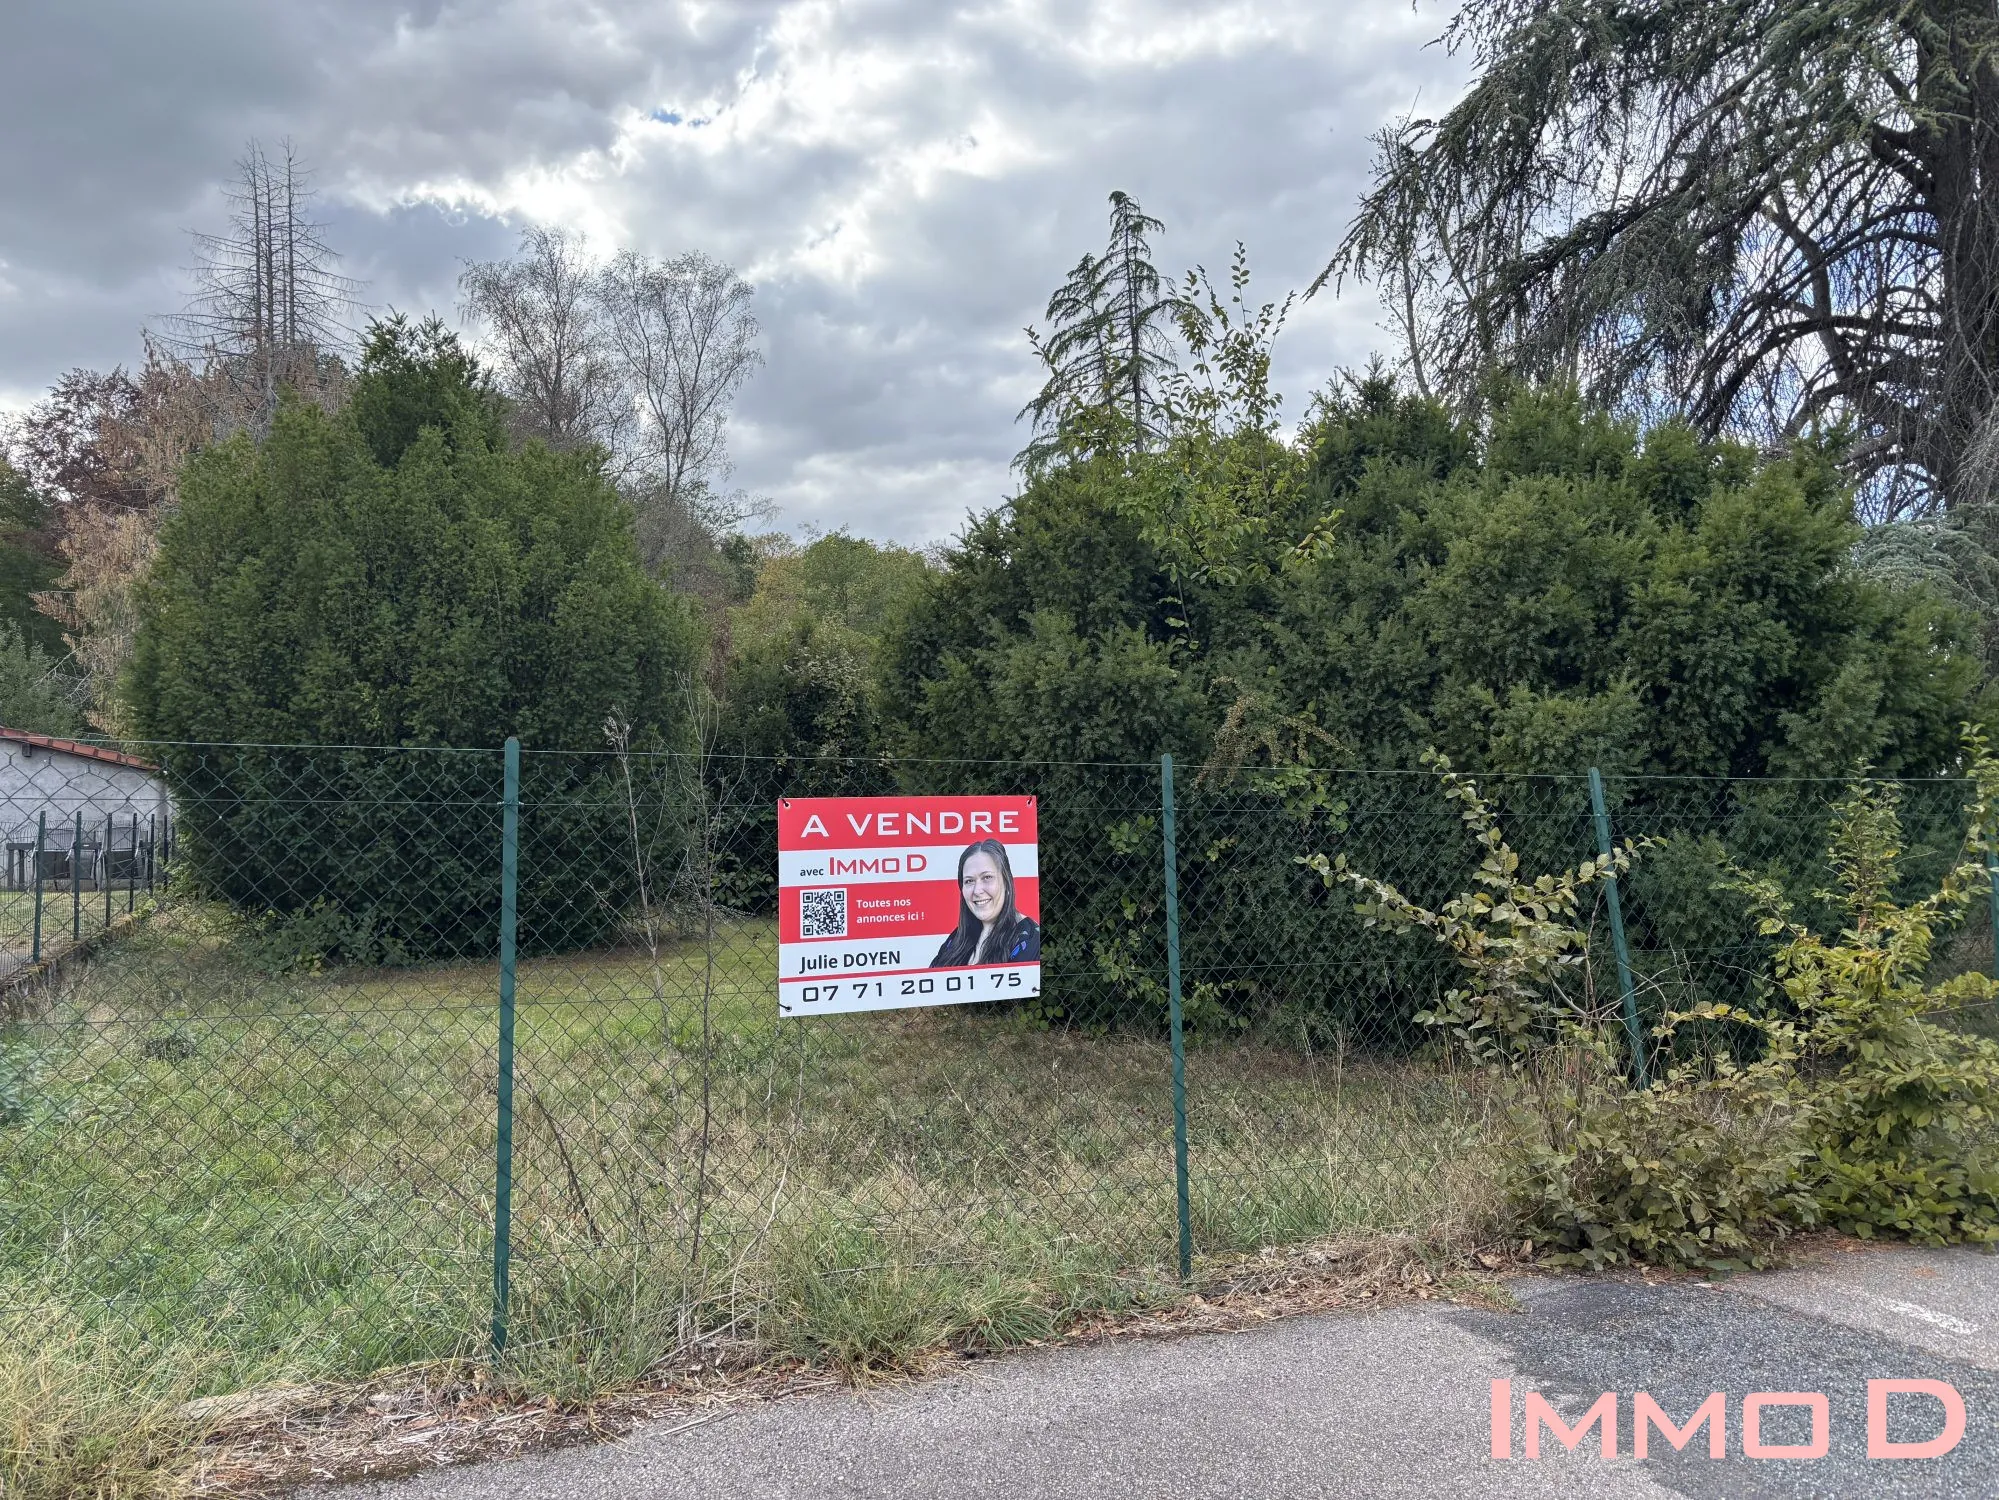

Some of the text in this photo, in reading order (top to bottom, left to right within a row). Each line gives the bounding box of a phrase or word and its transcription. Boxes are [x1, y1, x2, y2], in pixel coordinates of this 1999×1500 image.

[800, 811, 1019, 838] A VENDRE
[800, 866, 824, 877] avec
[856, 898, 911, 909] Toutes nos
[856, 912, 905, 924] annonces
[907, 910, 919, 921] ici
[799, 950, 900, 974] Julie DOYEN
[802, 972, 1021, 1003] 07 71 20 01 75
